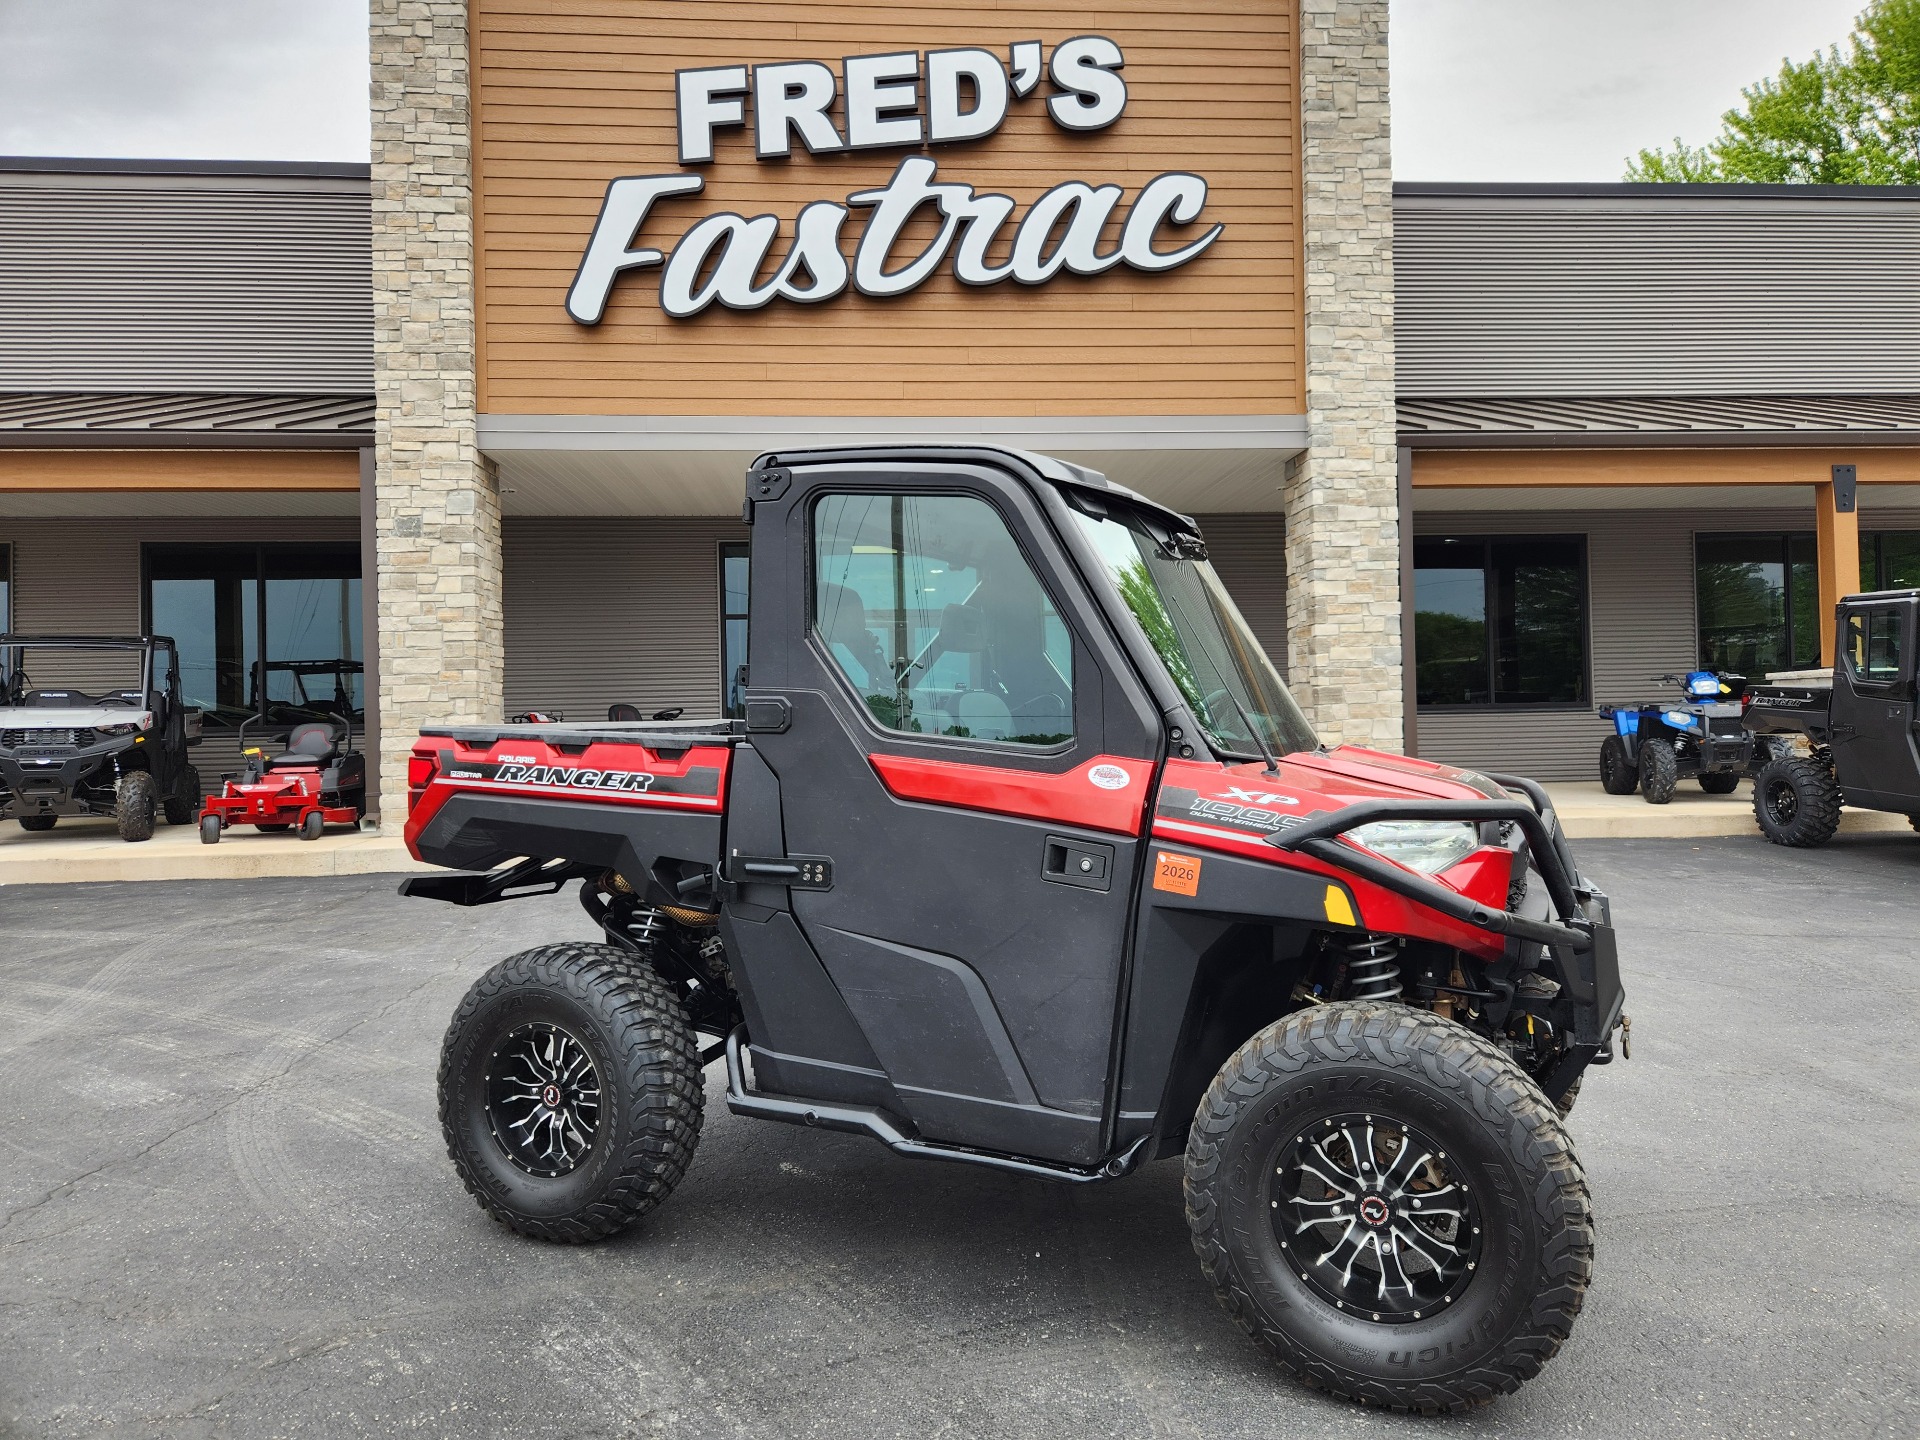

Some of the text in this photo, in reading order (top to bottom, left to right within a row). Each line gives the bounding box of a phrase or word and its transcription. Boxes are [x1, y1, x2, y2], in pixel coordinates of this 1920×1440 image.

[675, 35, 1128, 164] FRED'S
[565, 156, 1225, 326] Fastrac
[498, 755, 536, 764] POLARIS
[494, 763, 654, 792] RANGER
[1209, 786, 1299, 805] XP
[1189, 810, 1280, 832] DUAL OVERHEAD
[1162, 864, 1194, 880] 2026
[1386, 1162, 1526, 1369] BFGoodrich
